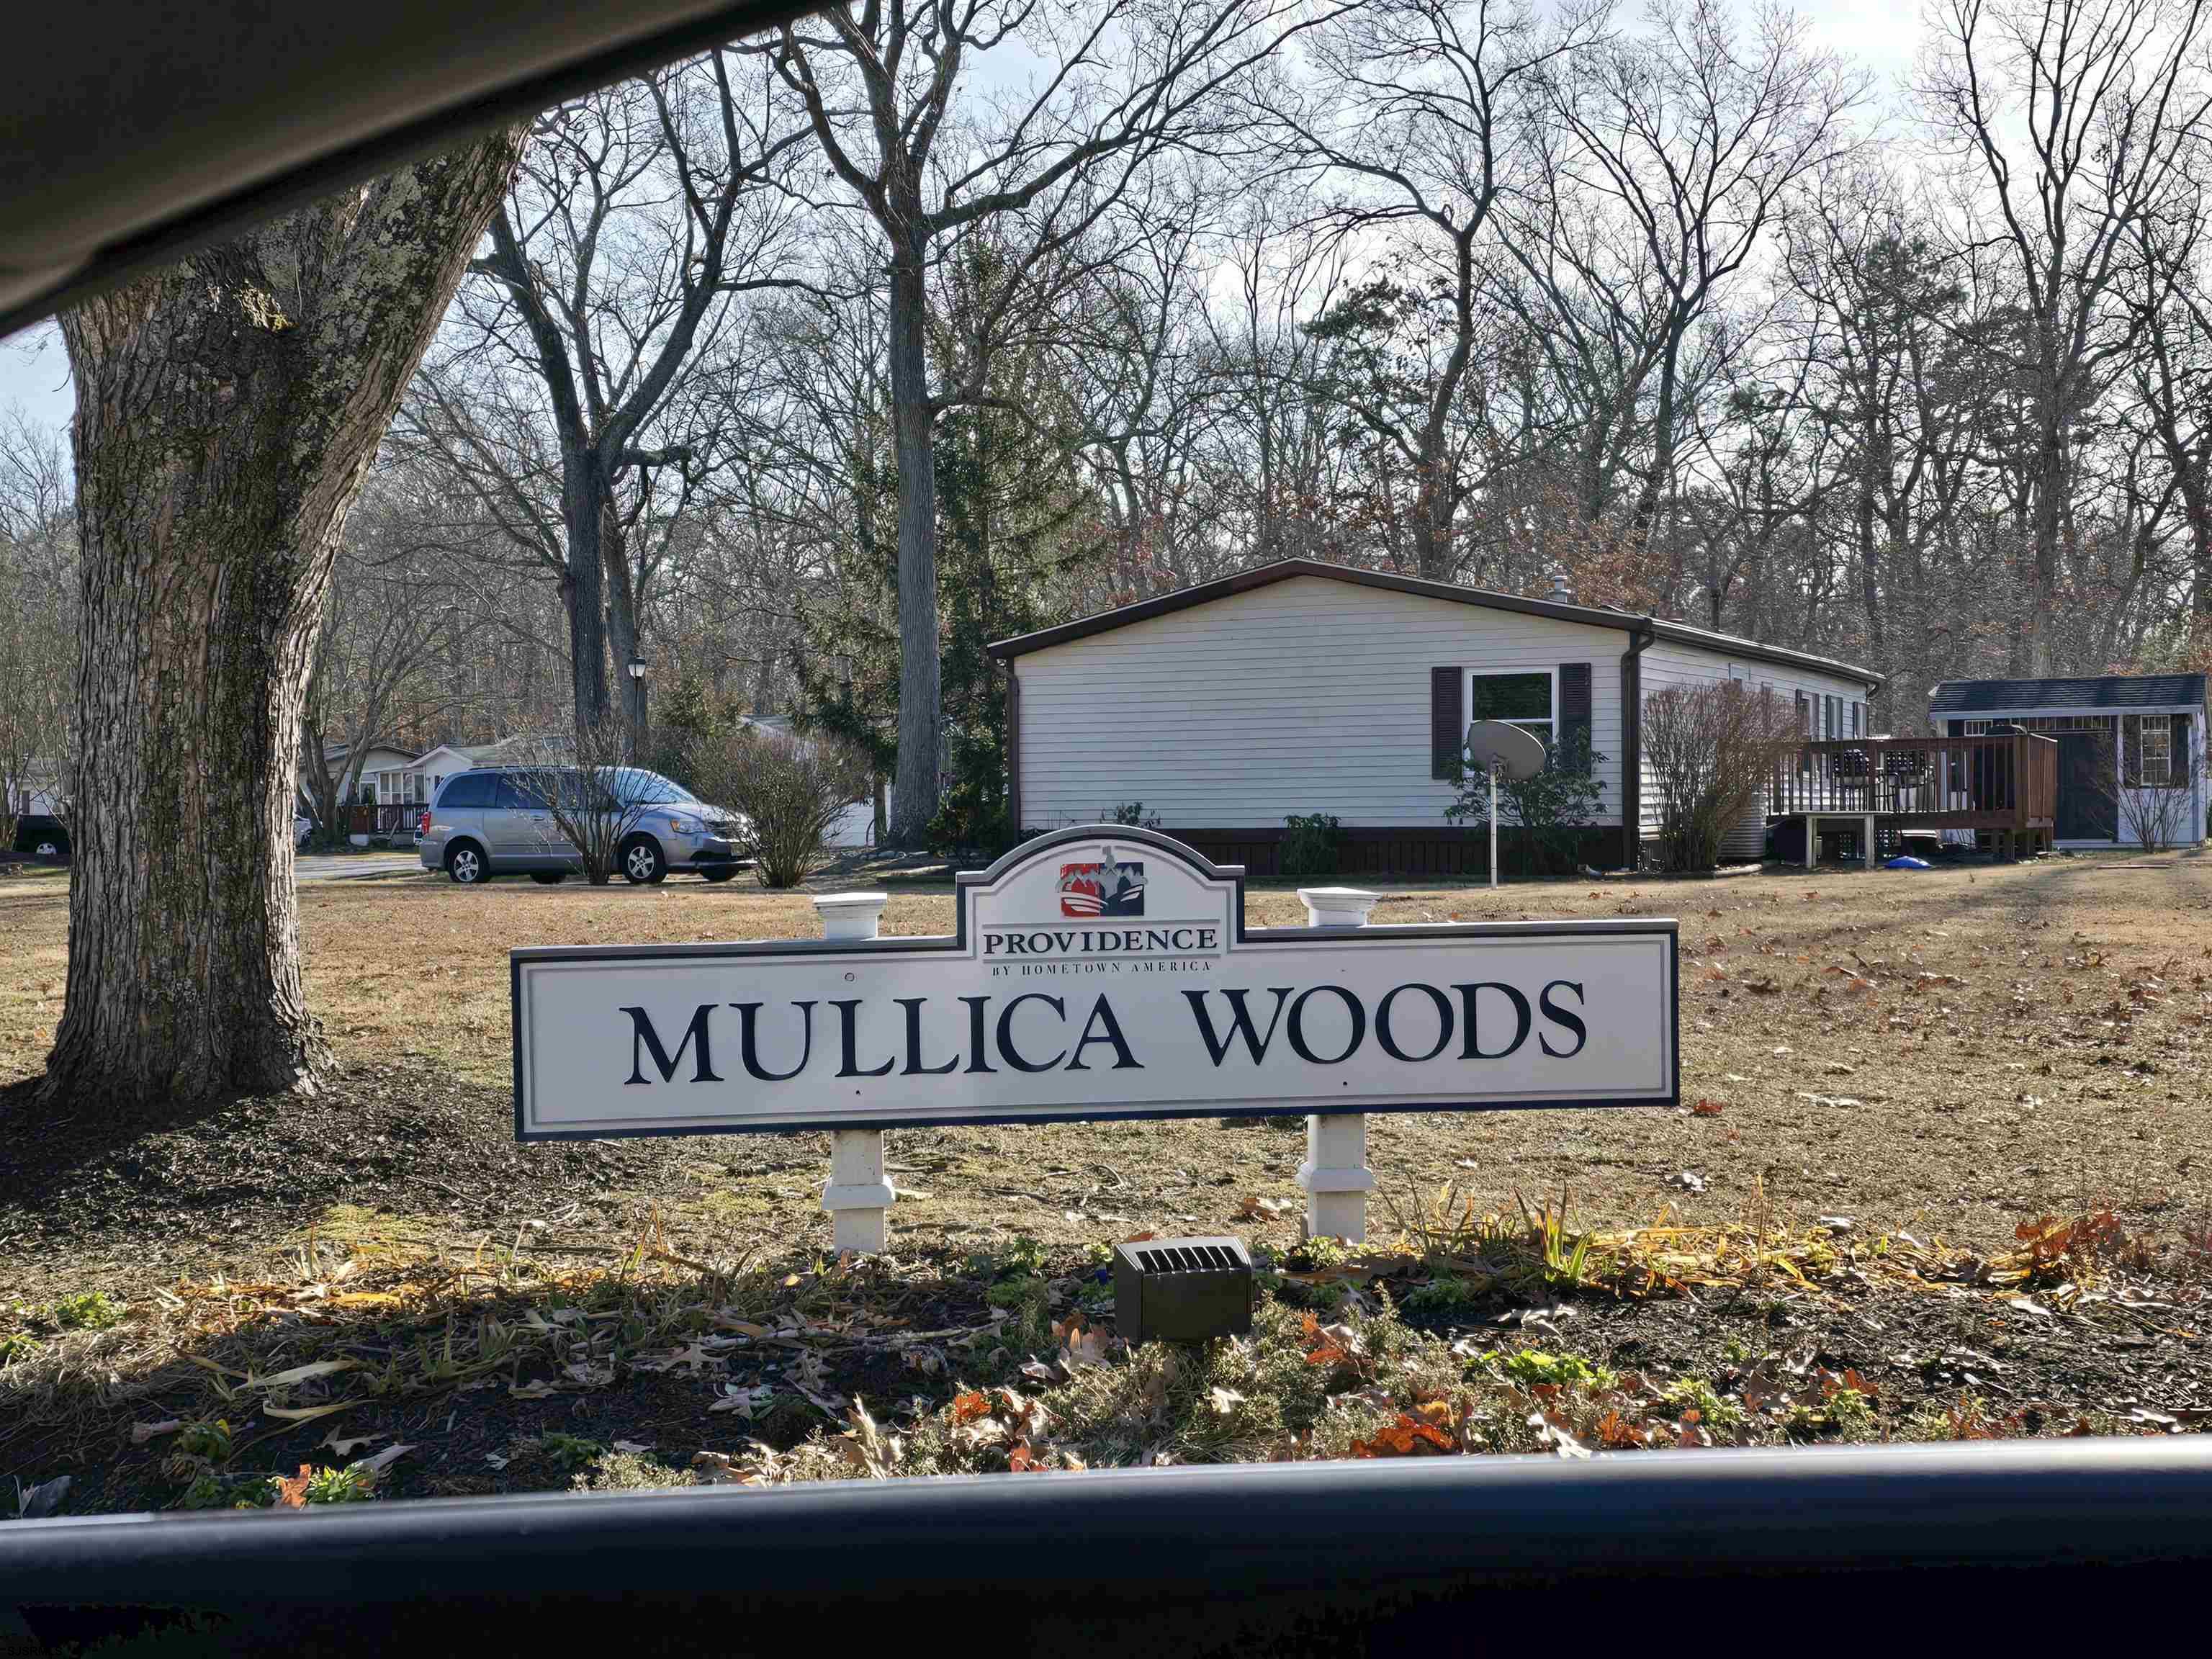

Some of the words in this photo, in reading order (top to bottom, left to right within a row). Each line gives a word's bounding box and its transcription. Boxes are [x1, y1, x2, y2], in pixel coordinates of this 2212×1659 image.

[984, 928, 1218, 955] PROVIDENCE
[992, 966, 1010, 977] BY
[1021, 962, 1121, 976] HOMETOWN
[1131, 961, 1213, 973] AMERICA
[619, 993, 1145, 1086] MULLICA
[1181, 979, 1587, 1067] WOODS
